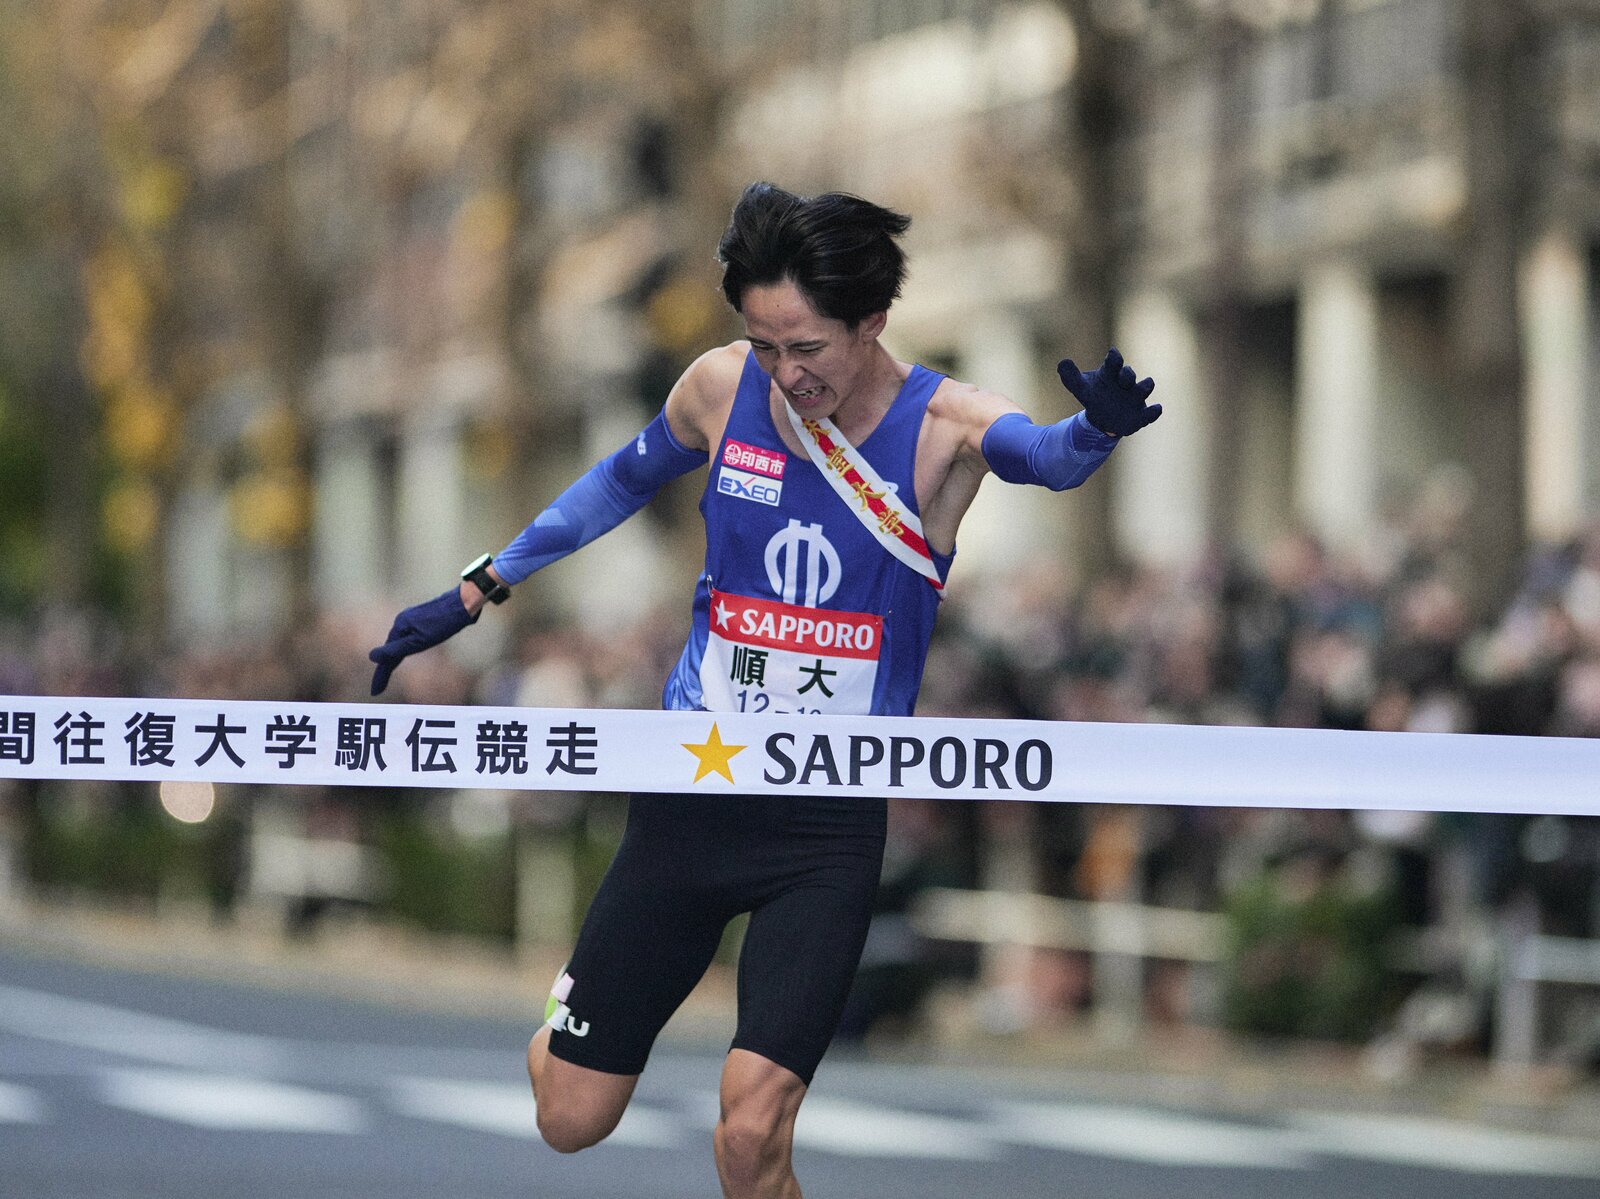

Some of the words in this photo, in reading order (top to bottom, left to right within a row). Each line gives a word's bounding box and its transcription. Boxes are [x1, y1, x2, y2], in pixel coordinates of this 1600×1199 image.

[740, 451, 785, 475] 印西市
[719, 476, 779, 504] EXEO
[739, 608, 875, 651] SAPPORO
[0, 710, 599, 776] 間往復大学駅伝競走
[763, 732, 1053, 791] SAPPORO
